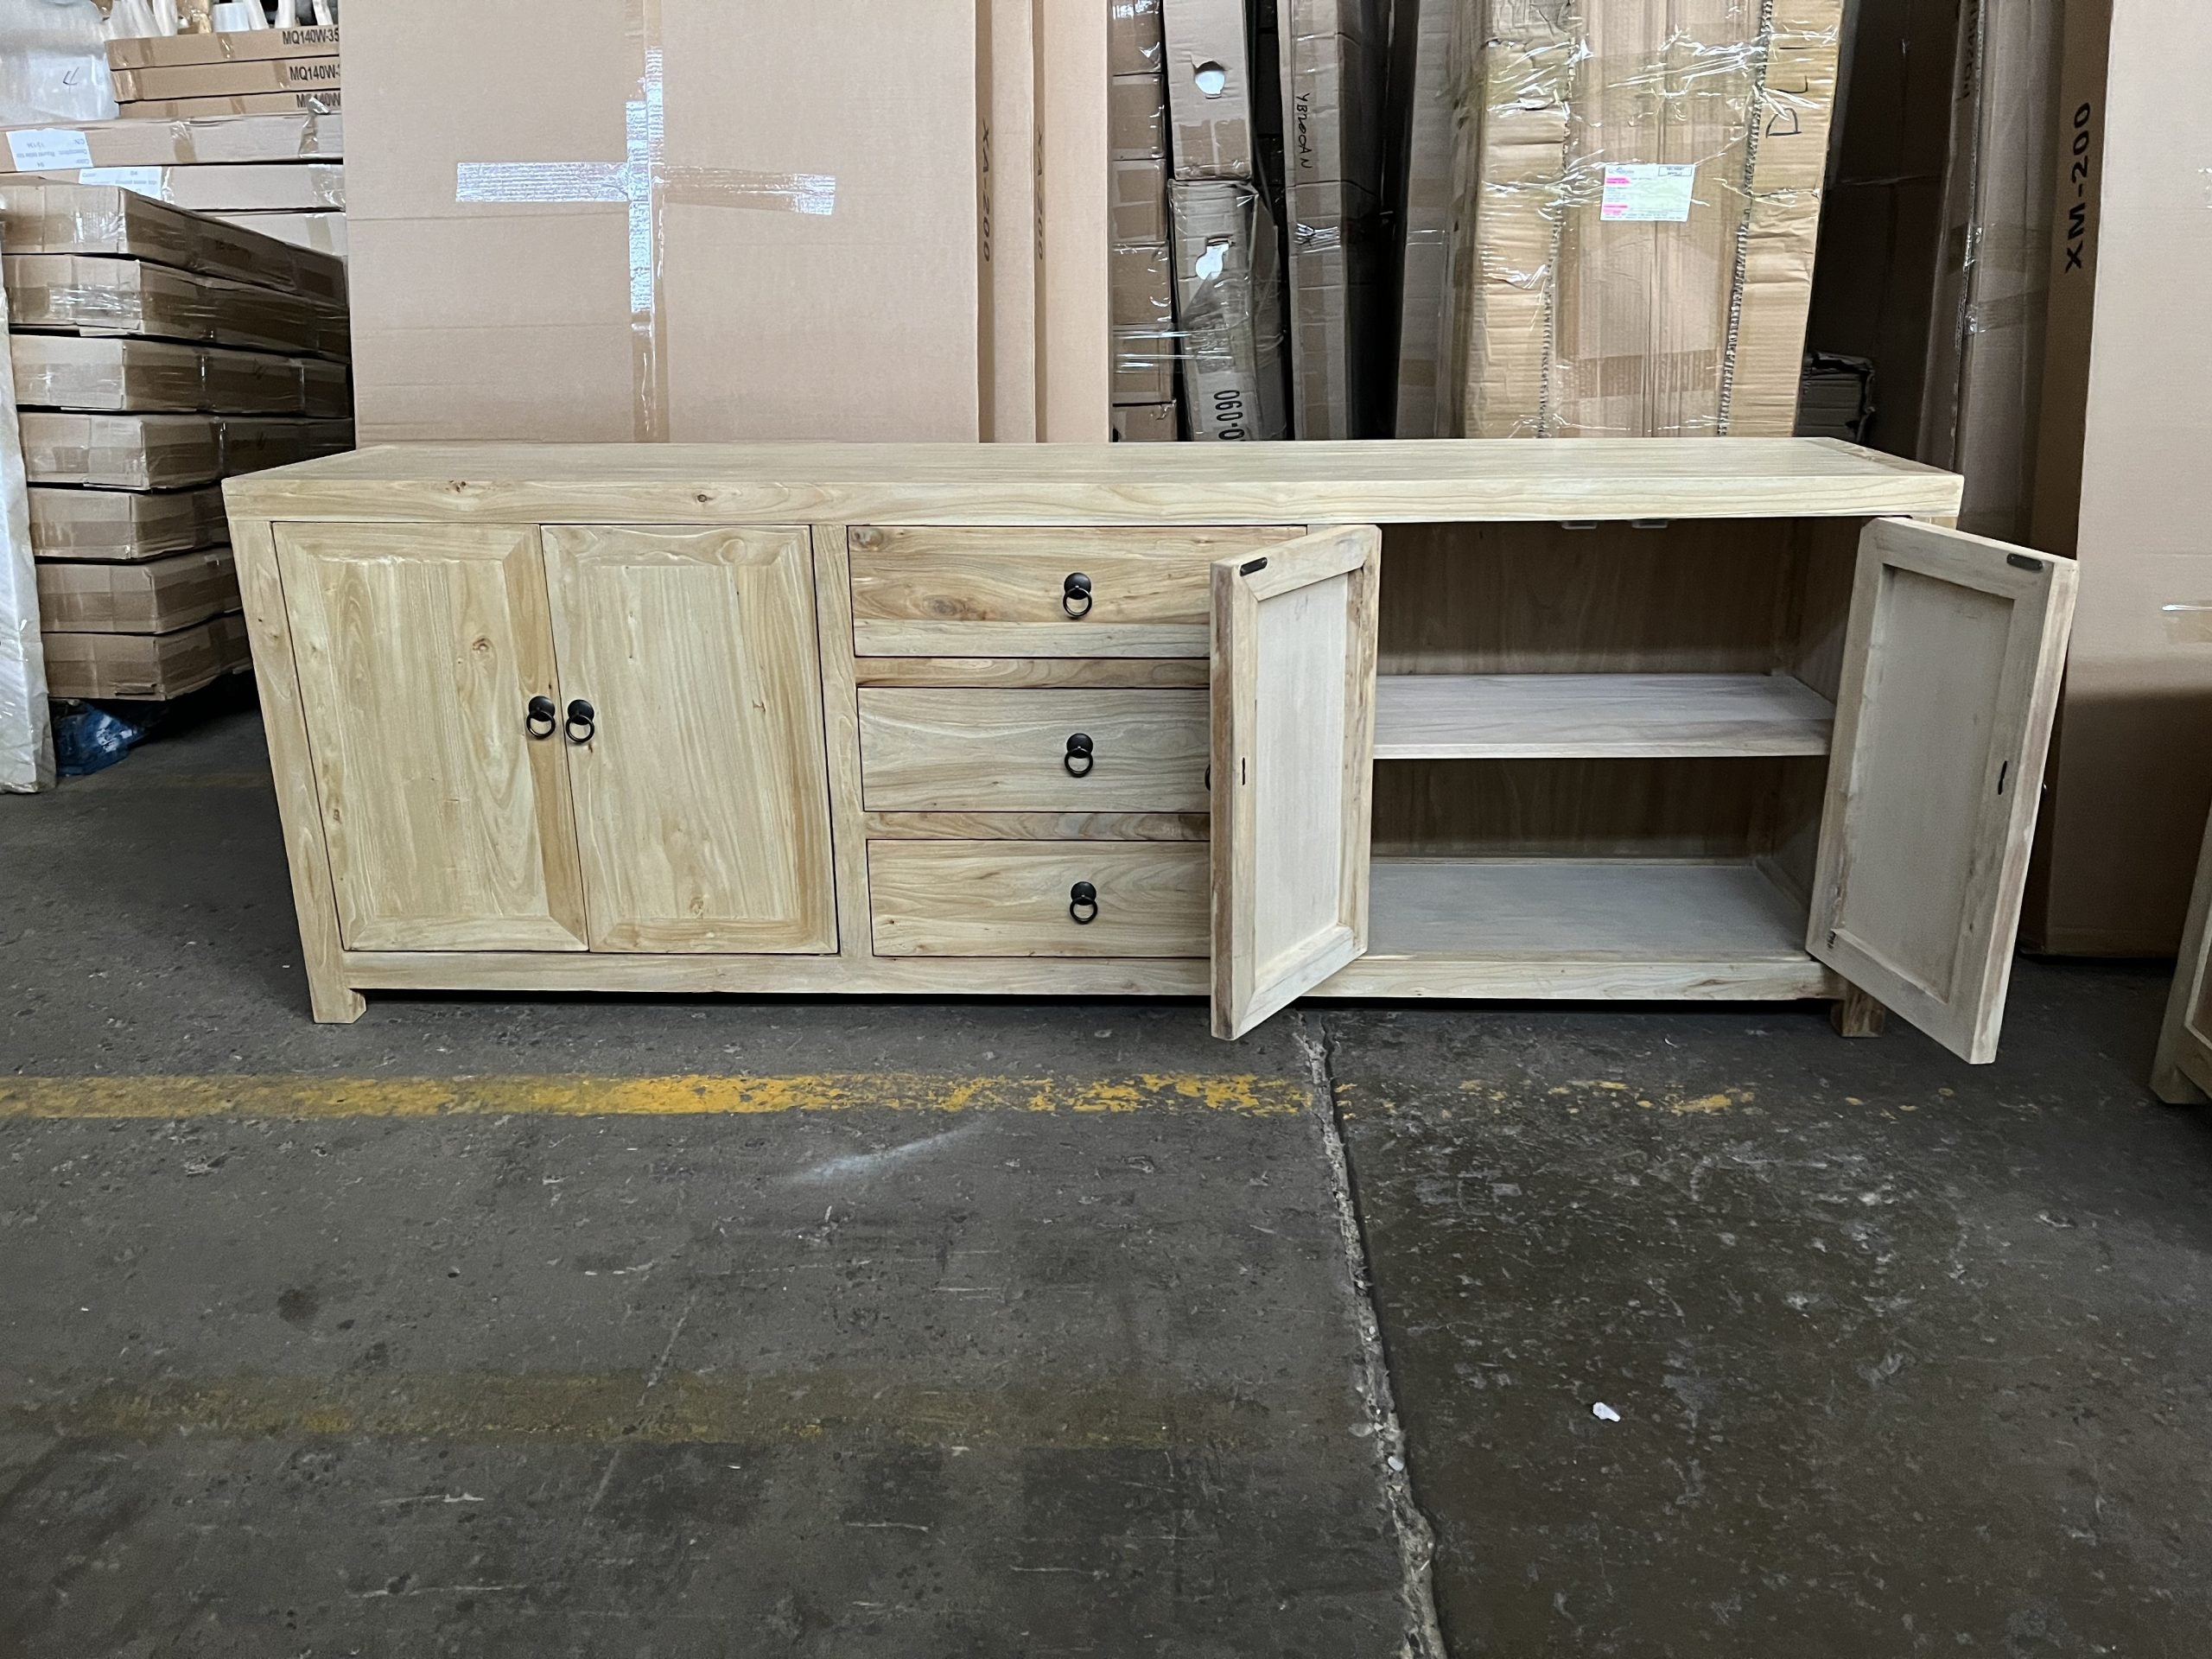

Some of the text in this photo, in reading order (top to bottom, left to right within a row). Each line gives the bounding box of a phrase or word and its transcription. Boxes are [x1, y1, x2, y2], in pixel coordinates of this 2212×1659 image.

[283, 28, 339, 44] MQ140W-35
[289, 64, 340, 80] MQ140W-
[2064, 102, 2091, 274] XM-200
[1213, 390, 1246, 442] 0-090
